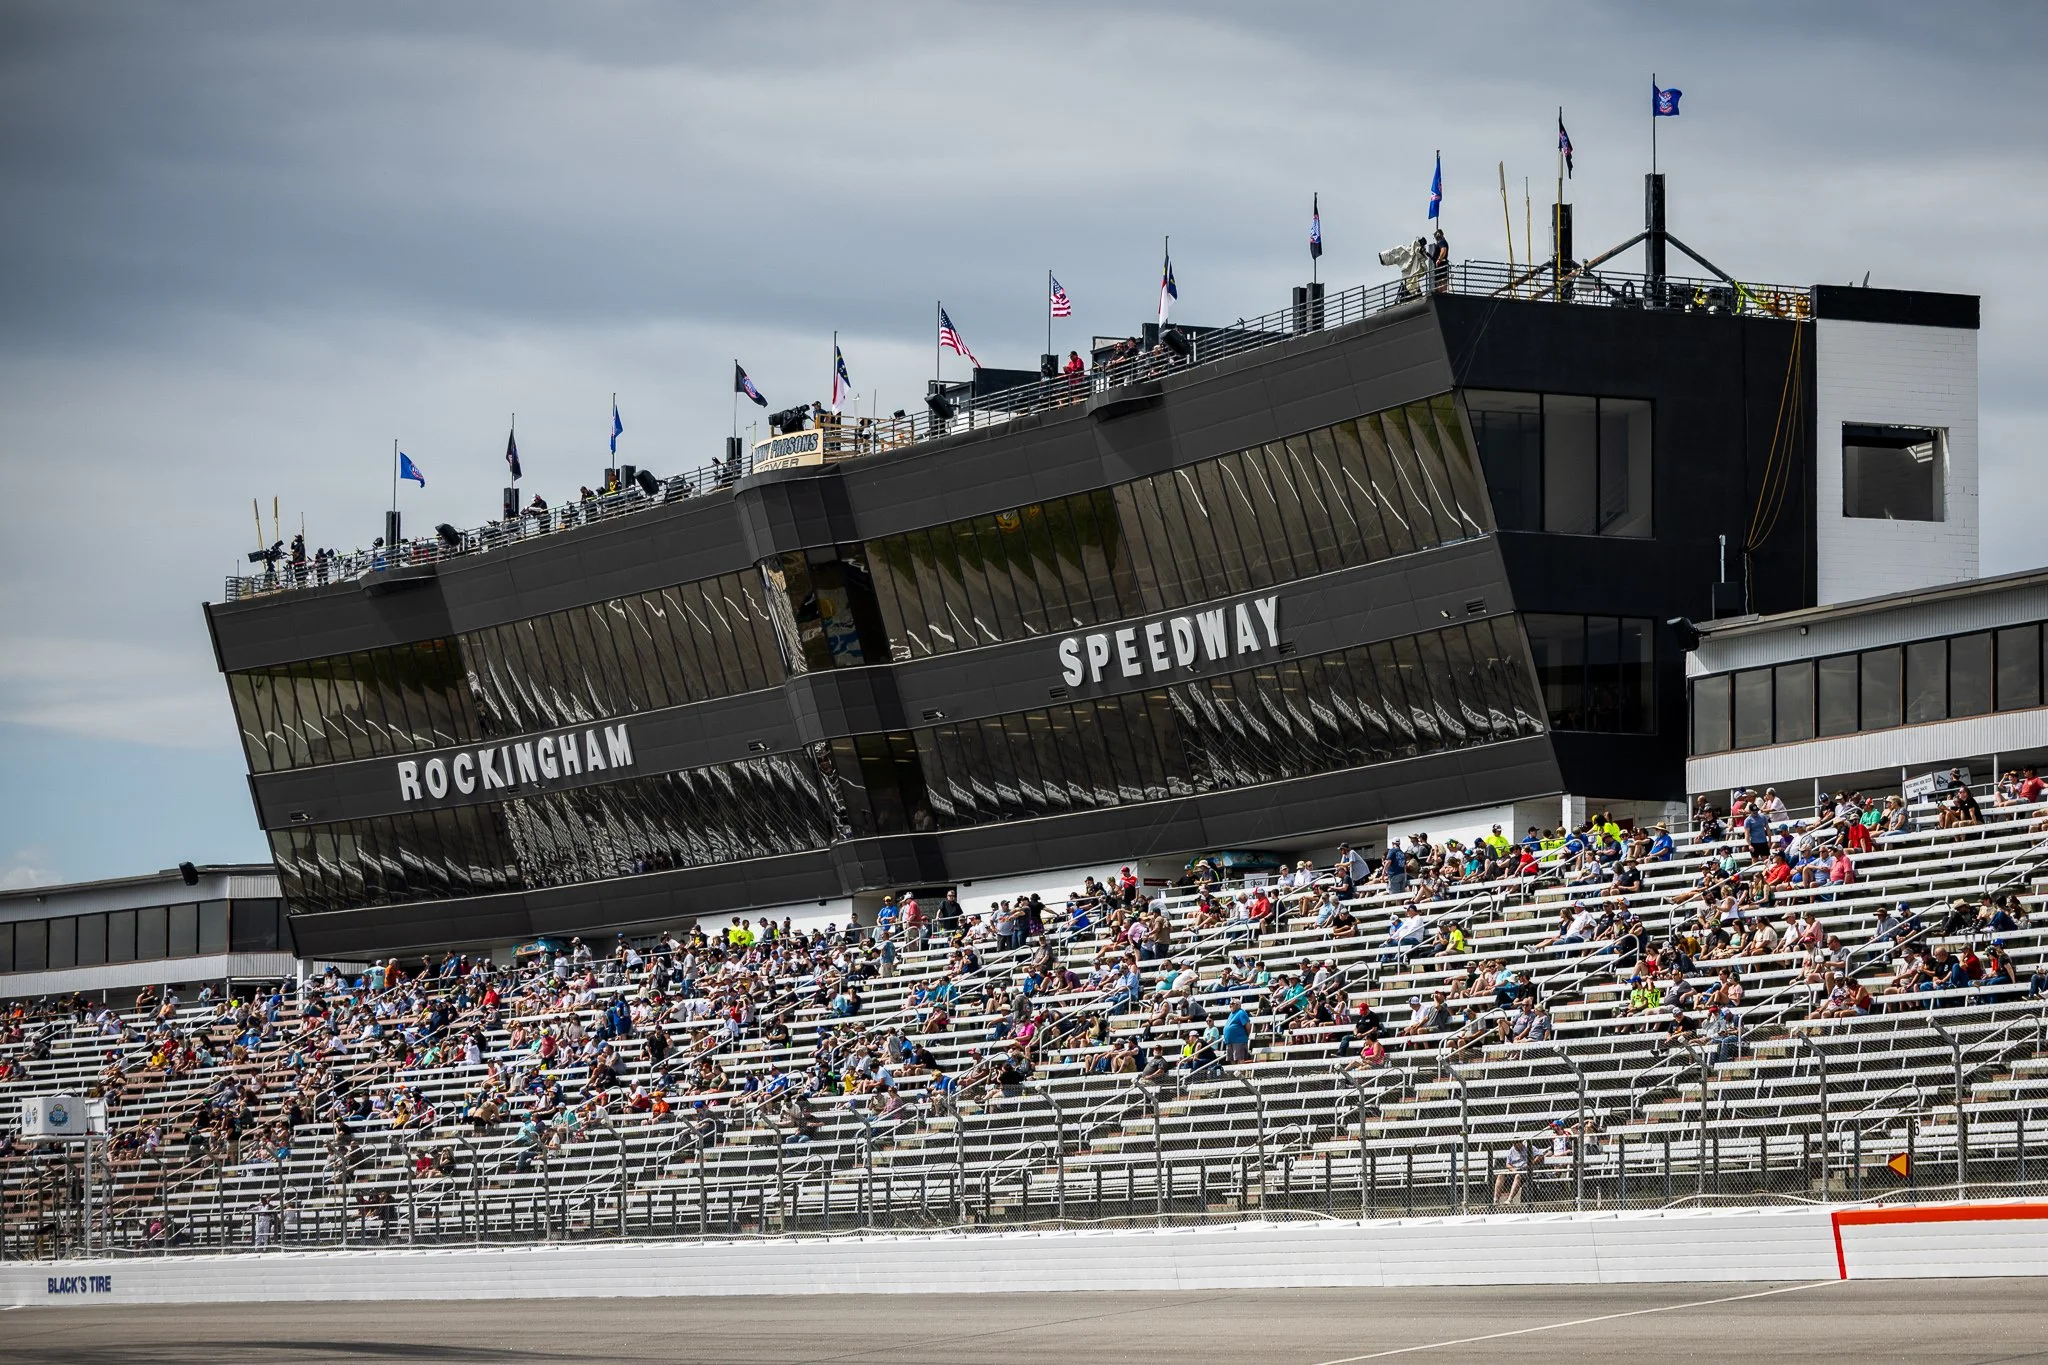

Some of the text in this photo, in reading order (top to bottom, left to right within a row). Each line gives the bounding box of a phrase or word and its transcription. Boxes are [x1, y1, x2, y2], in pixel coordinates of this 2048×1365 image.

[770, 433, 819, 458] PARSONS
[760, 458, 799, 471] TOWER
[1059, 596, 1280, 687] SPEEDWAY
[397, 724, 634, 801] ROCKINGHAM
[47, 1275, 112, 1294] BLACK'S TIRE
